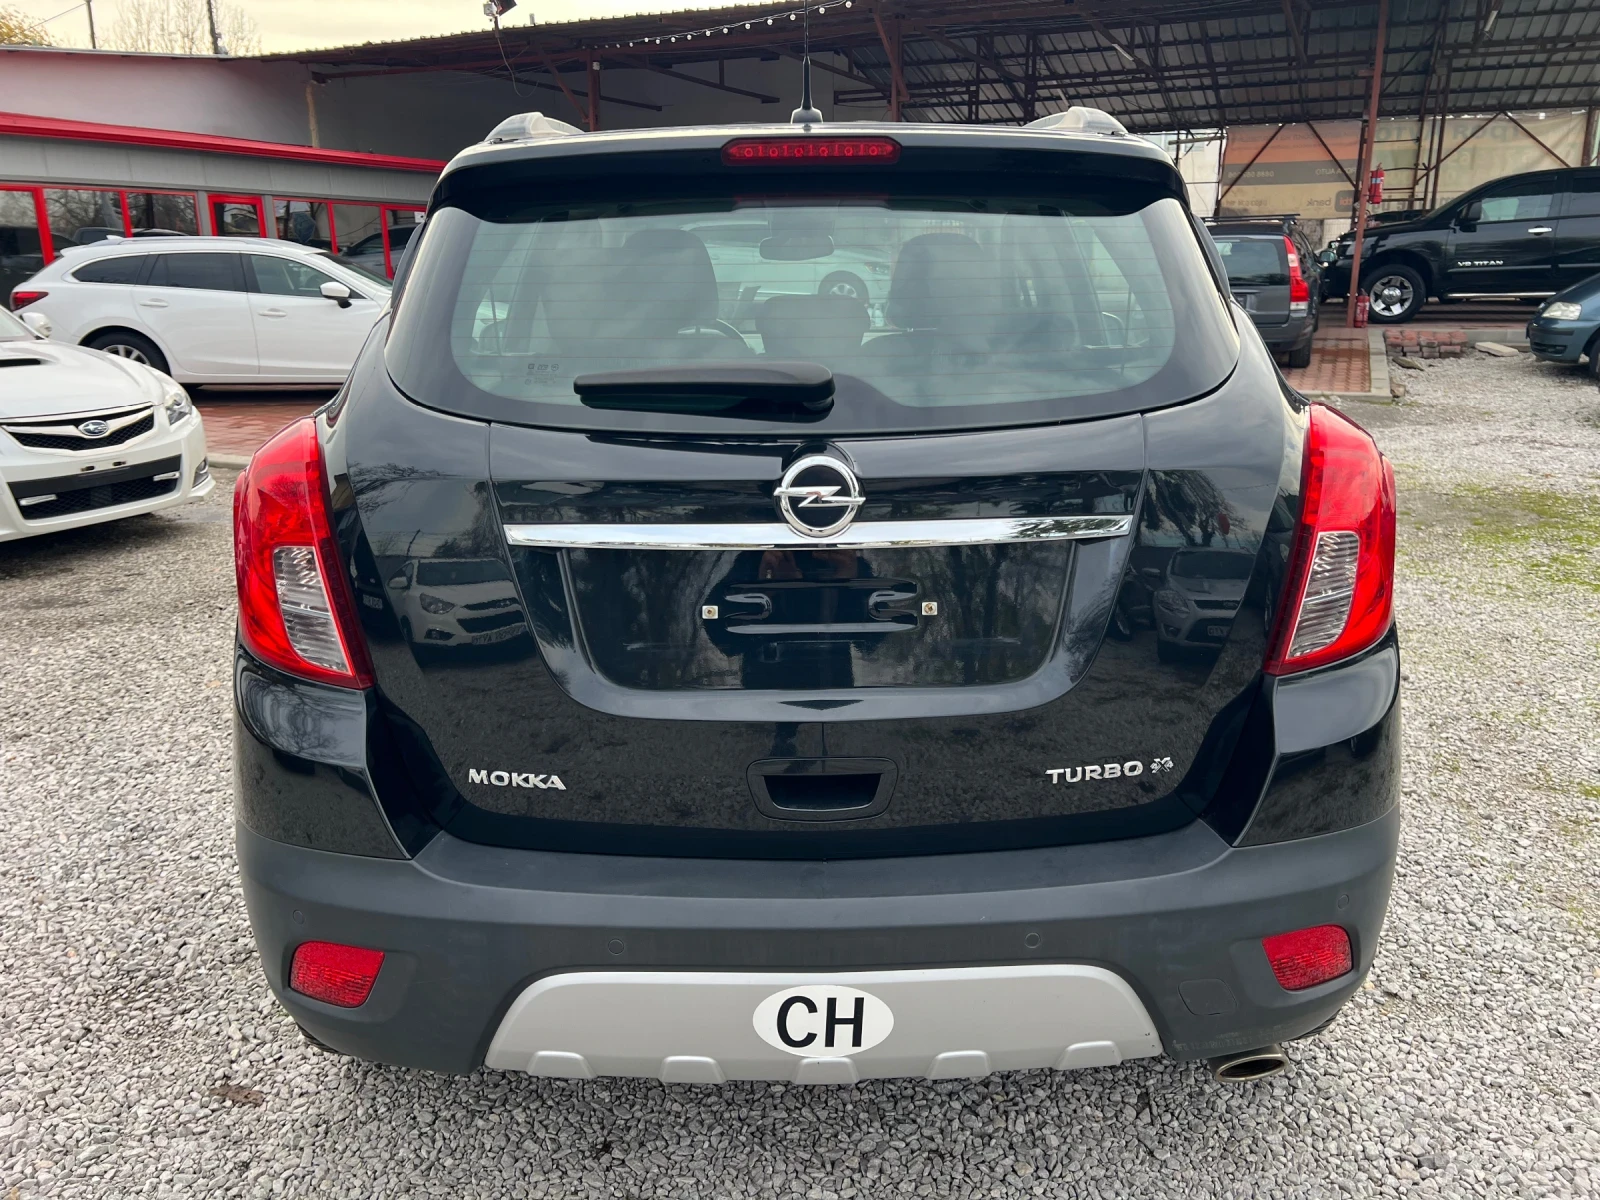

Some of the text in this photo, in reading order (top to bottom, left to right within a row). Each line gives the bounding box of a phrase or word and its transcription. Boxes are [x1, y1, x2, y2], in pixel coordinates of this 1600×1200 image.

[468, 768, 567, 790] MOKKA
[1045, 760, 1144, 784] TURBO
[776, 995, 865, 1049] CH
